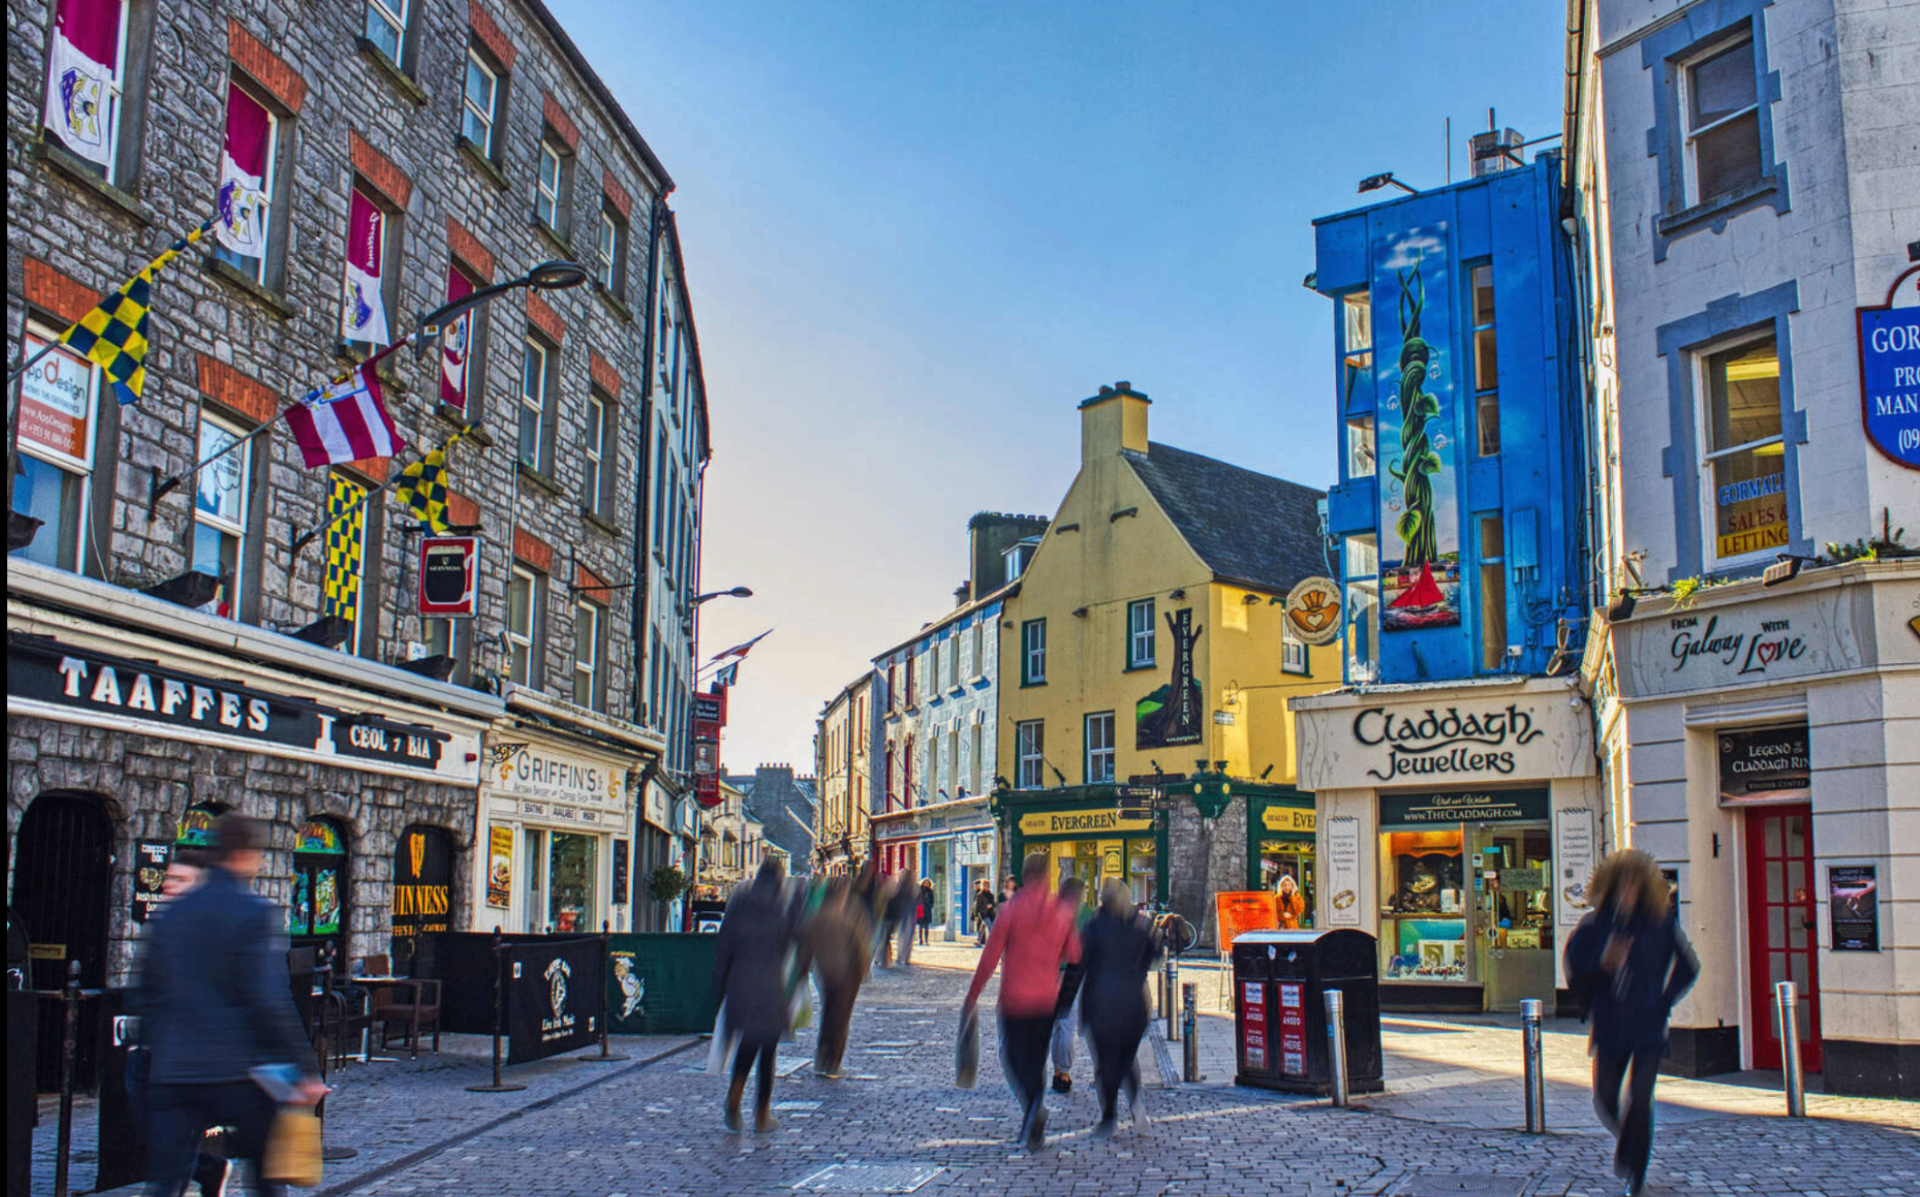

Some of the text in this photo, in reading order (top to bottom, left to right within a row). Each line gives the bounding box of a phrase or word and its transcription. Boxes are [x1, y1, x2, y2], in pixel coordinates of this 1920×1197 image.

[1728, 507, 1775, 534] SALES
[1671, 617, 1698, 630] FROM
[1761, 620, 1790, 632] WITH
[1671, 615, 1743, 672] Galway
[58, 656, 270, 732] TAAFFES
[350, 724, 388, 752] CEOL
[407, 735, 431, 759] BIA
[1353, 704, 1544, 753] Claddagh
[1366, 748, 1515, 780] Jewellers
[1749, 743, 1791, 757] LEGEND
[517, 750, 597, 792] GRIFFIN'S
[1732, 757, 1789, 773] CLADDAGH
[1051, 813, 1117, 831] EVERGREEN
[392, 885, 448, 915] UINNESS
[1284, 1039, 1301, 1051] HERE
